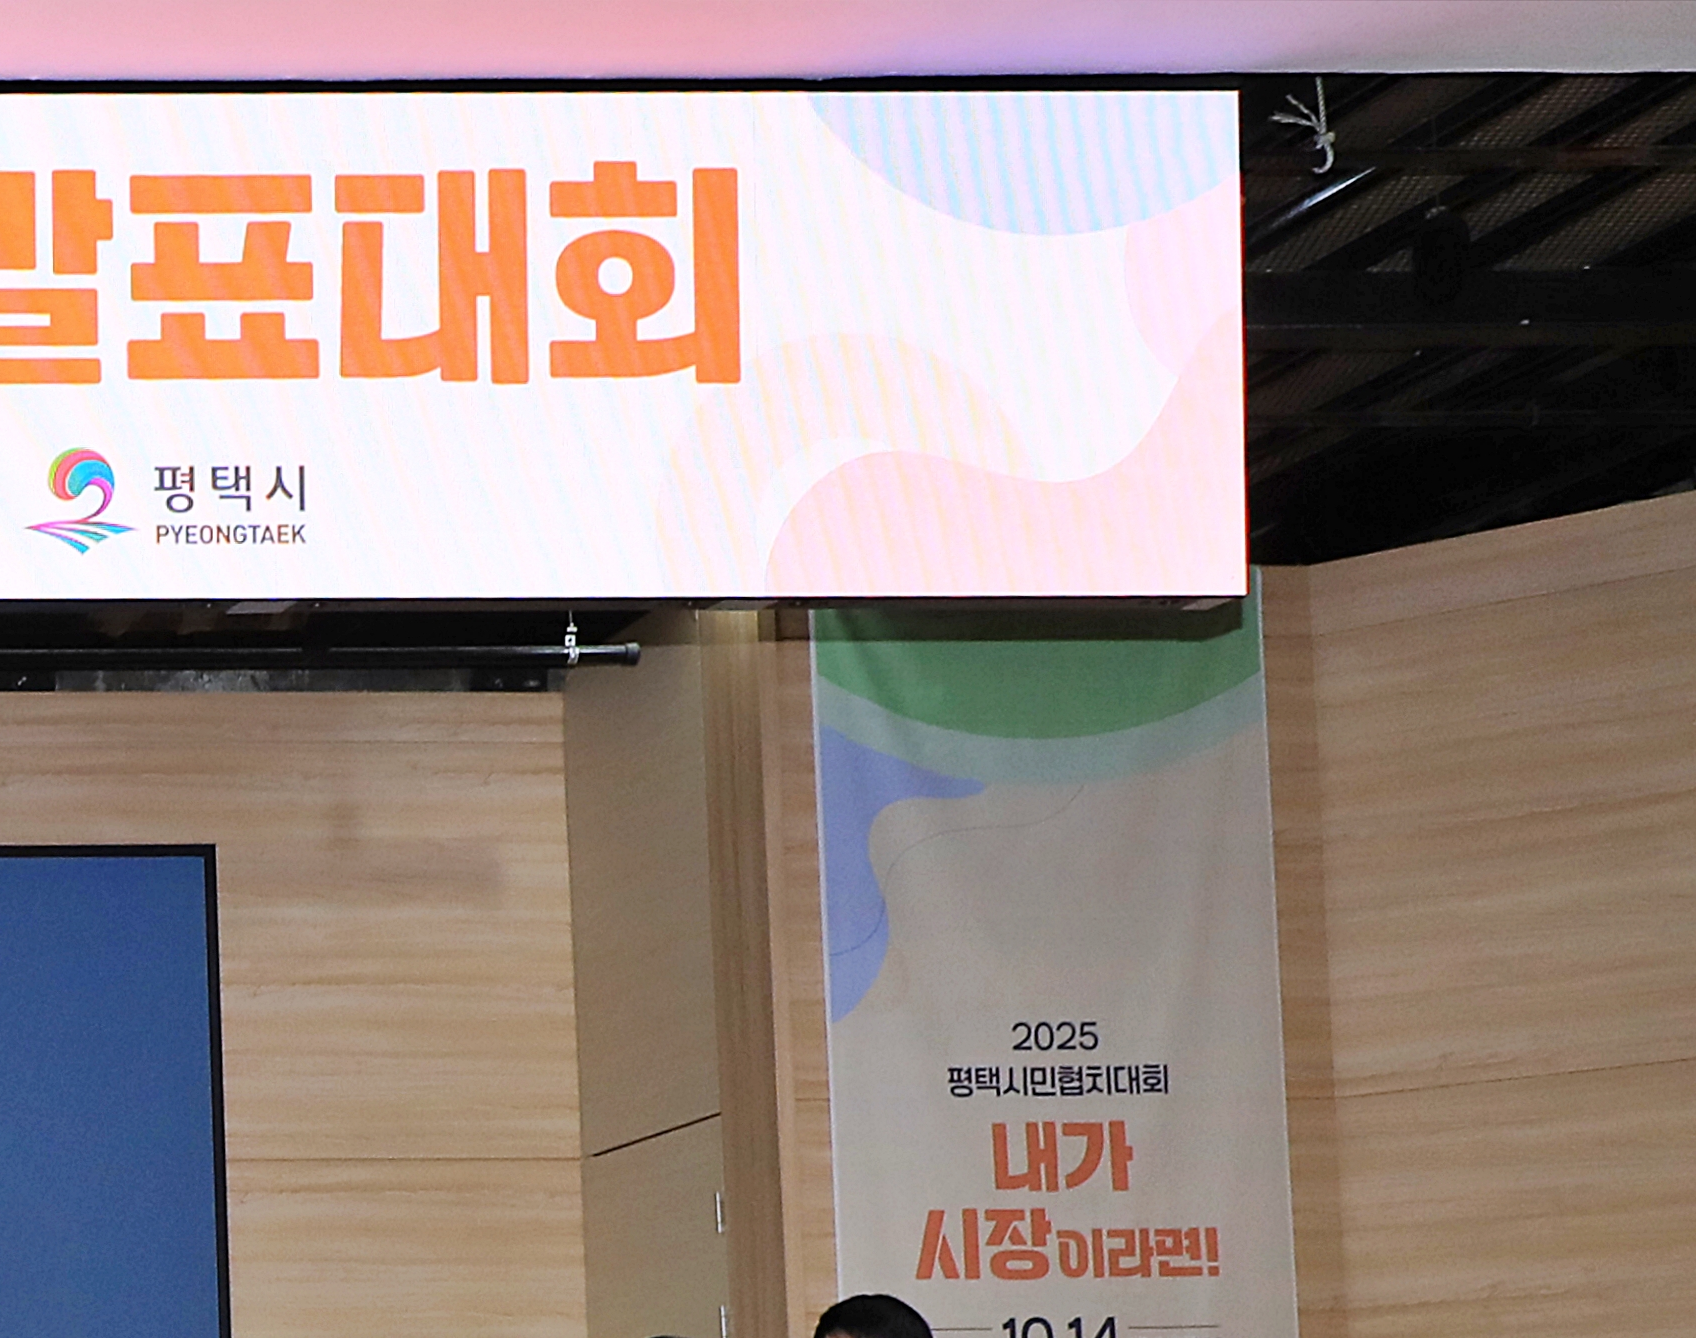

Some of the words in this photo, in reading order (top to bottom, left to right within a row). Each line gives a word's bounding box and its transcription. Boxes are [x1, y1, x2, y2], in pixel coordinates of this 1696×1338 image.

[152, 464, 306, 514] 평택시
[154, 523, 306, 546] PYEONGTAEK
[1012, 1021, 1099, 1052] 2025
[946, 1064, 1170, 1097] 평택시민협치대회
[991, 1120, 1134, 1193] 내가
[915, 1208, 1221, 1281] 시장이라면!
